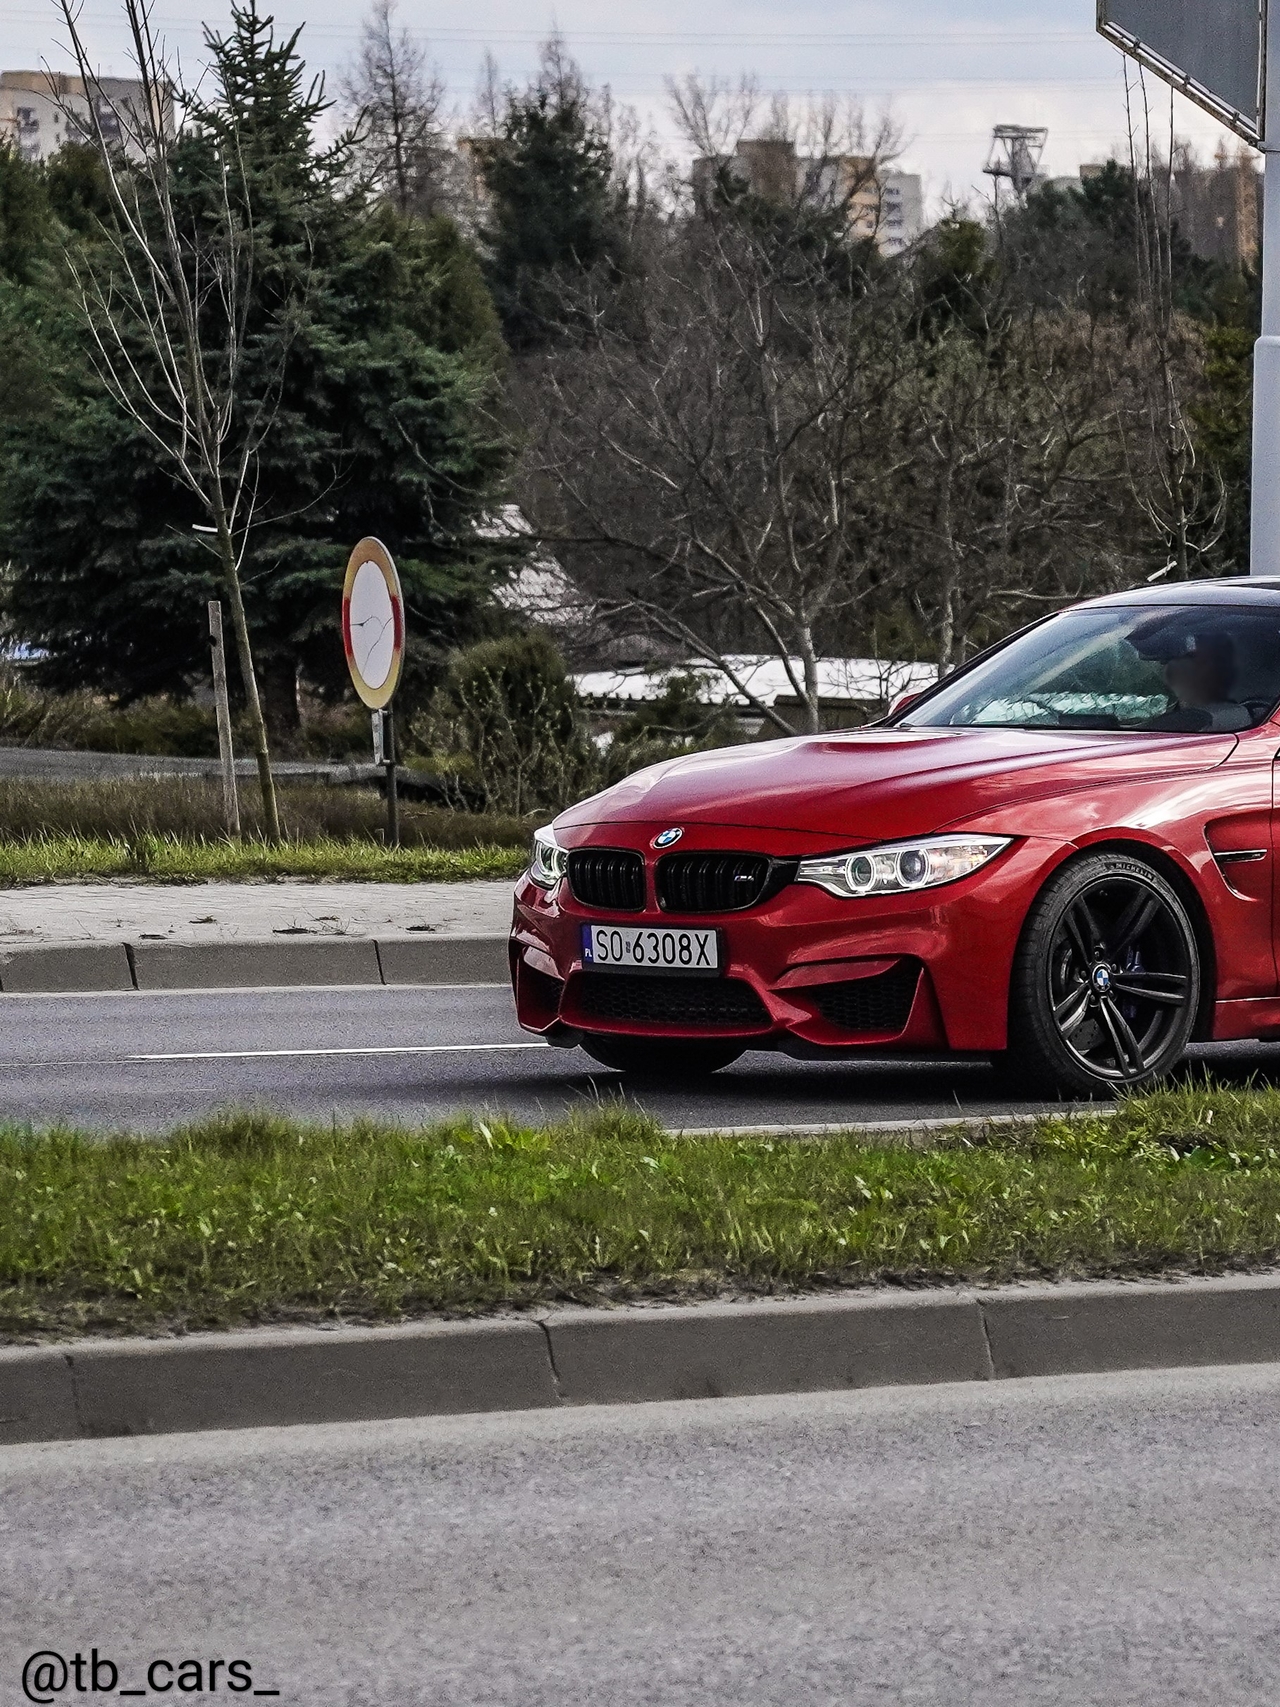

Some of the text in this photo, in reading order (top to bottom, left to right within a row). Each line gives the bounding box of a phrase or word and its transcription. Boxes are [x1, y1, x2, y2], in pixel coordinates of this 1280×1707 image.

[1115, 863, 1153, 880] MICHELIN
[584, 947, 593, 957] PL
[596, 929, 711, 966] SO 6308X
